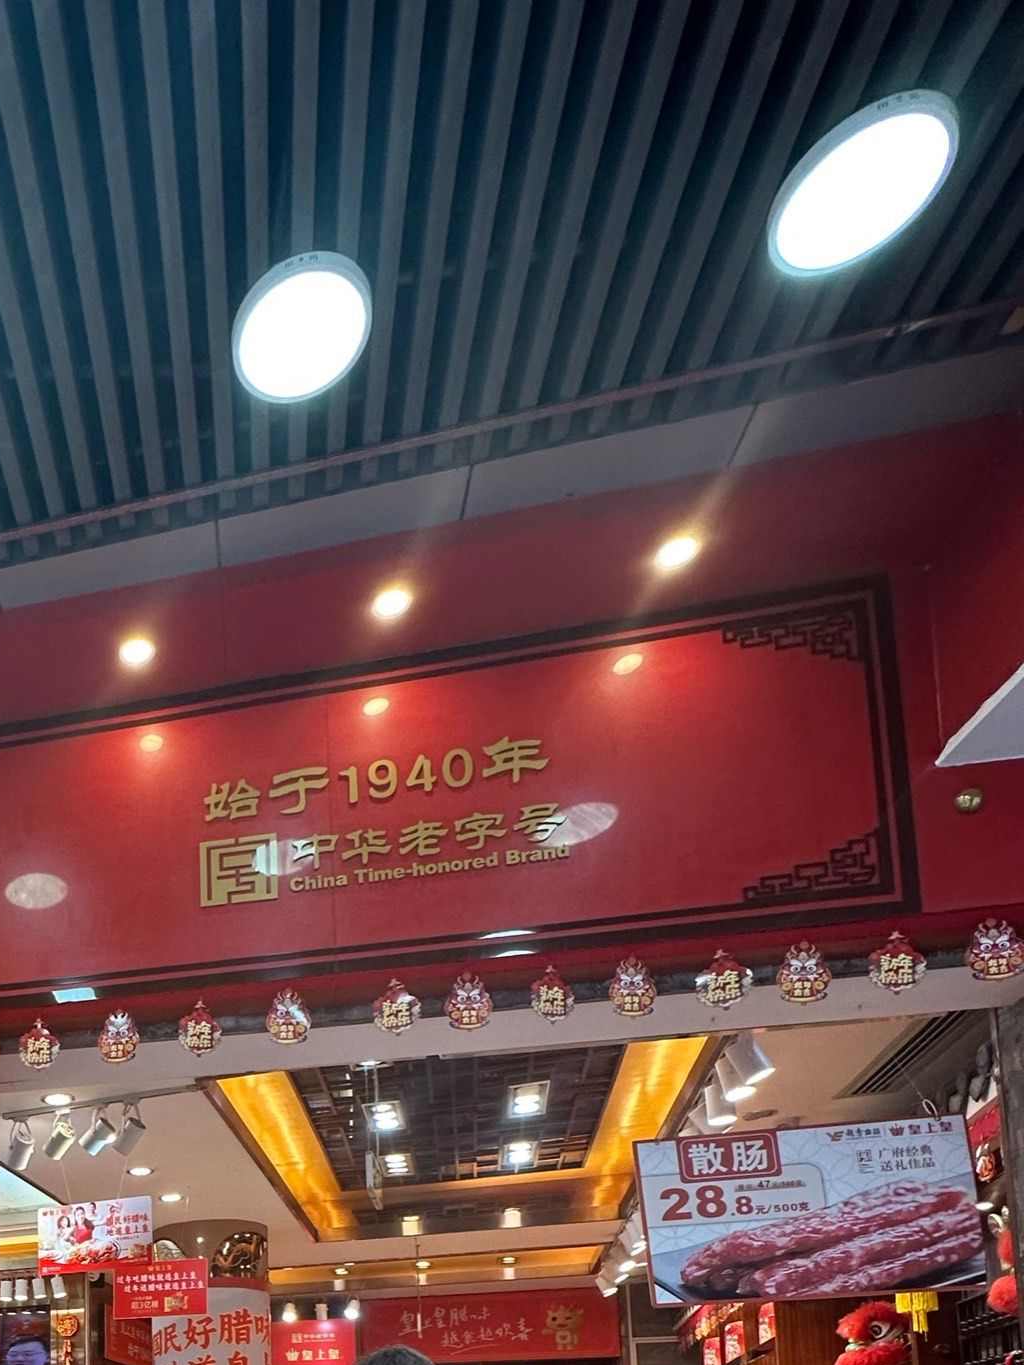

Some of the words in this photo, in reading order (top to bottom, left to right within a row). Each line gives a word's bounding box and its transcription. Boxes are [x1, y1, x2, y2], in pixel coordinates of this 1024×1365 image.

[203, 736, 550, 822] 始于1940年
[291, 802, 568, 870] 中华老字号
[290, 872, 349, 892] China
[354, 852, 499, 884] Time-honored
[505, 843, 570, 867] Brand
[687, 1139, 769, 1175] 散肠
[878, 1144, 933, 1159] 广府经典
[881, 1158, 935, 1172] 送礼佳品
[301, 1348, 340, 1361] 皇上皇
